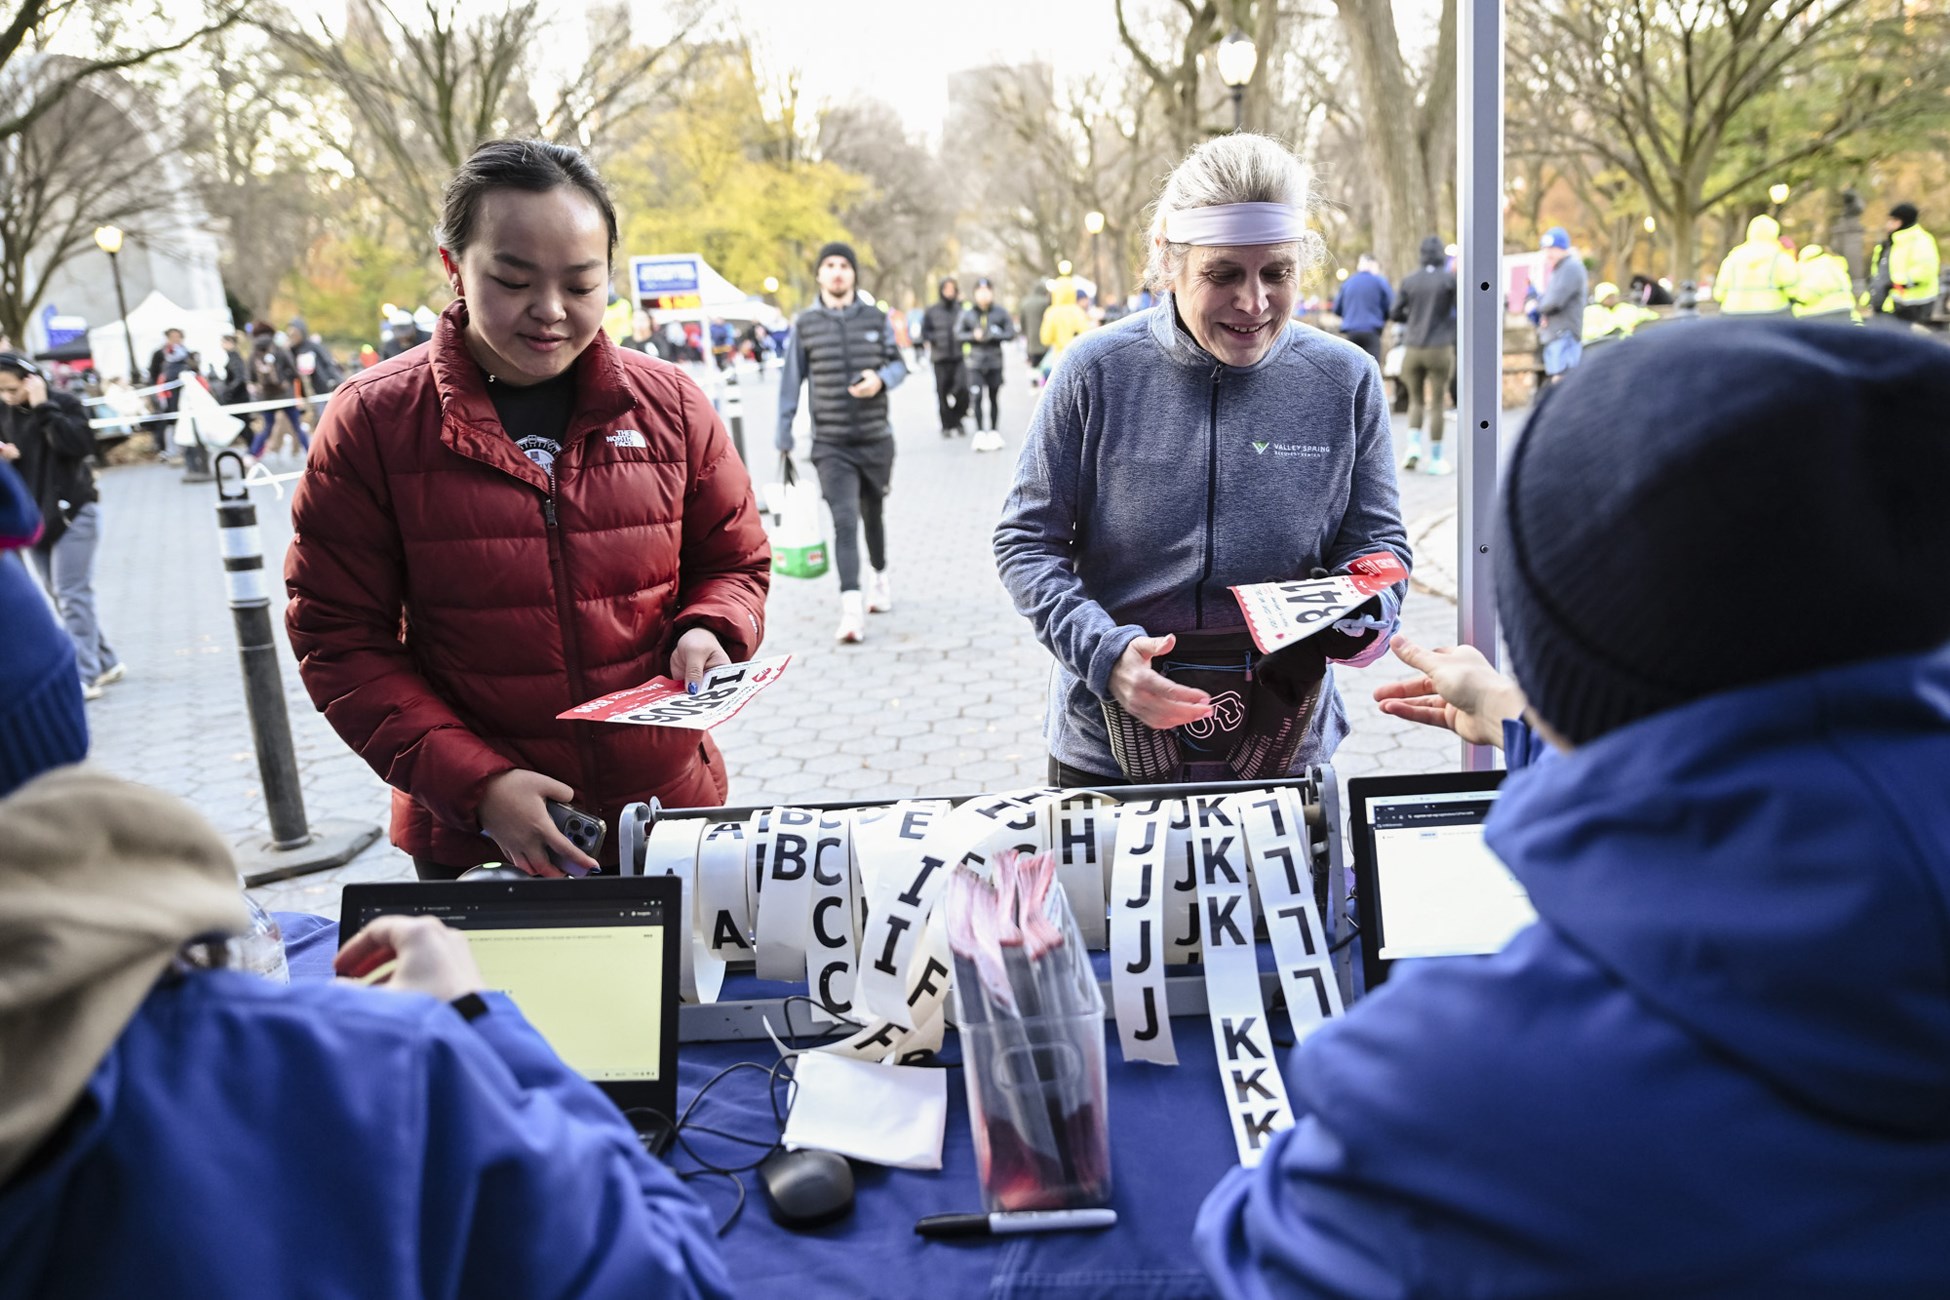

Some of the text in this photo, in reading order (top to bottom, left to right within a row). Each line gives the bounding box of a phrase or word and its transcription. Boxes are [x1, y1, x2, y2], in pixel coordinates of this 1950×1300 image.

[1274, 443, 1330, 453] VALLEY SPRING
[899, 811, 933, 840] E
[1196, 797, 1235, 828] K
[772, 833, 807, 880] B
[813, 837, 843, 886] C
[1061, 818, 1096, 864] H
[1129, 822, 1157, 855] J
[1201, 836, 1240, 885] K
[898, 855, 945, 907] I
[1125, 864, 1153, 909] J
[1173, 841, 1197, 892] J
[712, 910, 750, 949] A
[813, 896, 848, 949] C
[1174, 903, 1199, 946] J
[1206, 895, 1248, 947] K
[874, 914, 911, 976] I
[1125, 920, 1152, 974] J
[819, 961, 852, 1013] C
[907, 956, 949, 1007] F
[853, 1022, 909, 1050] F
[1134, 987, 1160, 1041] J
[1221, 1017, 1266, 1061] K
[1231, 1068, 1278, 1103] K
[1242, 1109, 1280, 1150] K
